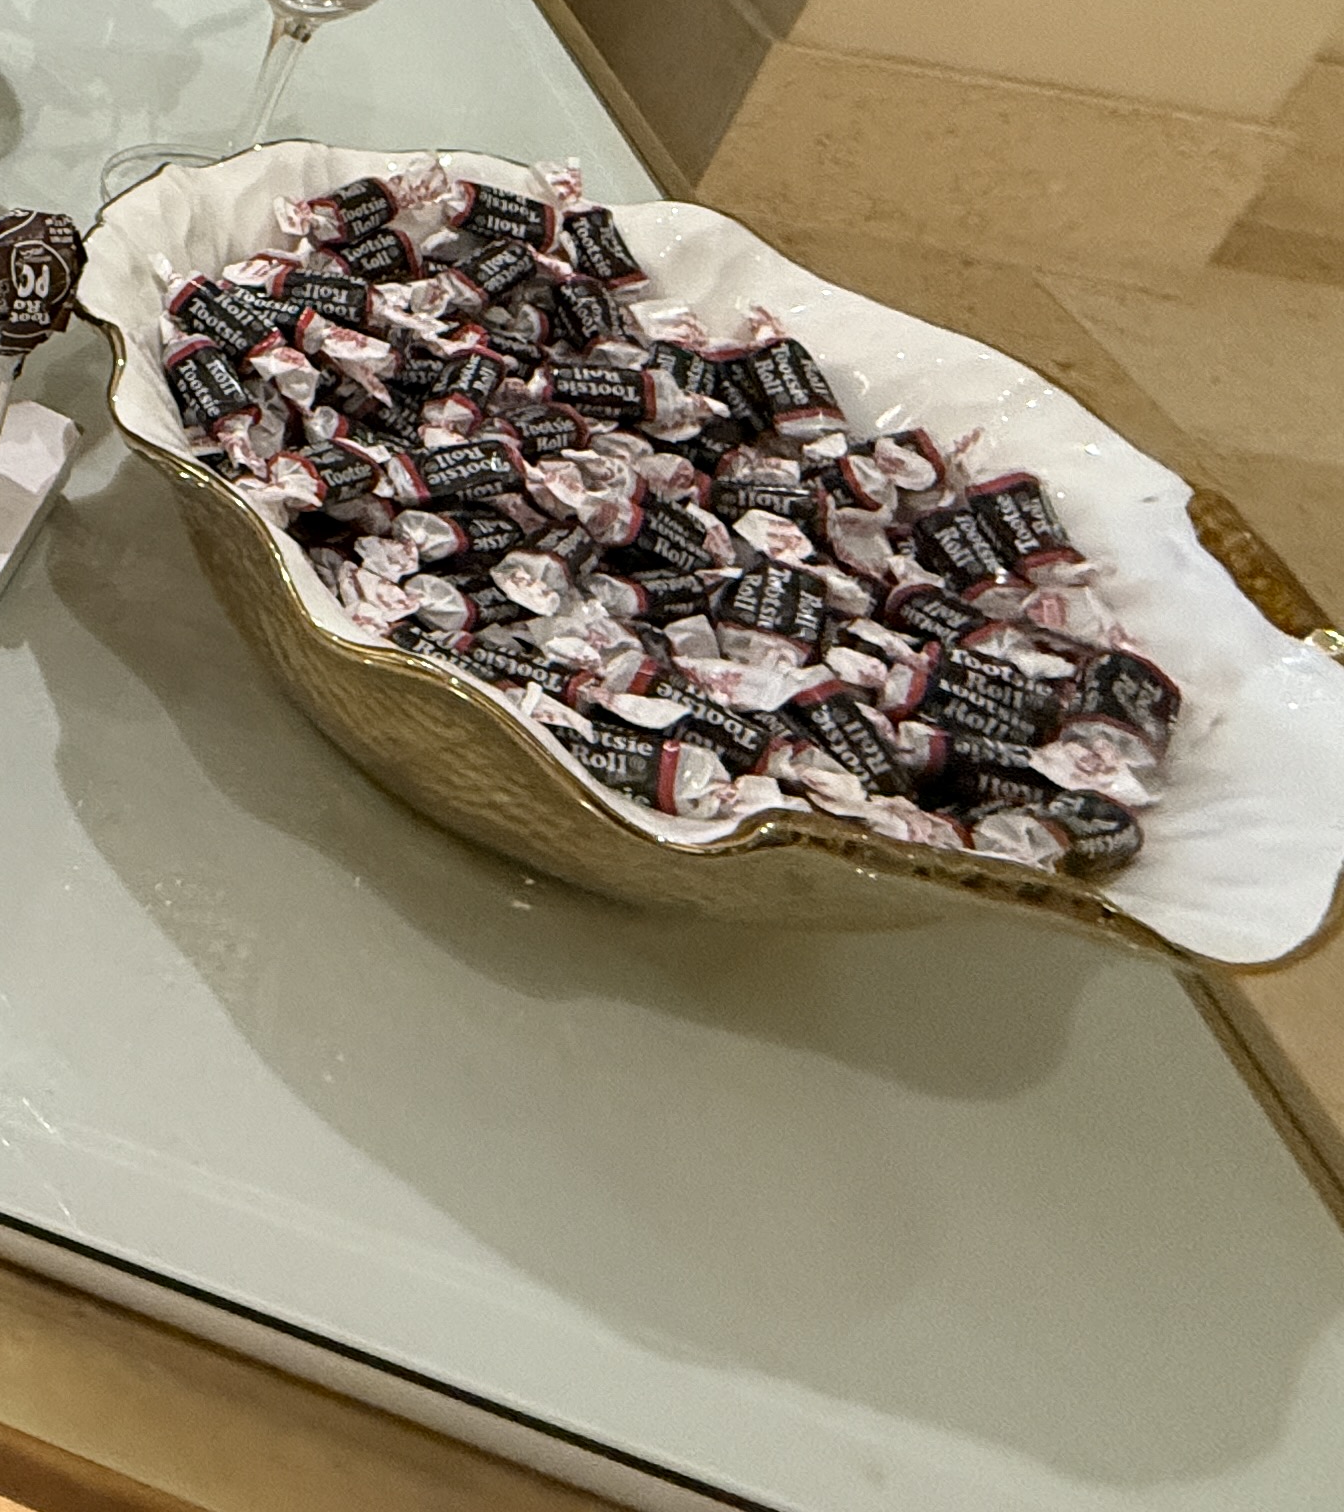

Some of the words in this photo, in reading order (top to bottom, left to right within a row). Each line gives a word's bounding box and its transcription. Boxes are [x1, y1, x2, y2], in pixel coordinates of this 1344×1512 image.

[340, 195, 388, 224] Tootsie
[486, 214, 528, 239] Roll
[341, 233, 397, 262] Tootsie
[572, 216, 613, 278] Tootsie
[10, 311, 52, 326] Toot
[12, 298, 43, 314] Ro
[213, 292, 256, 332] Roll
[189, 296, 249, 351] Tootsie
[178, 358, 221, 418] Tootsie
[754, 358, 786, 398] Roll
[769, 342, 811, 406] Tootsie
[557, 378, 643, 404] Tootsie
[319, 462, 374, 488] Tootsie
[426, 453, 512, 486] Tootsie
[435, 446, 486, 472] Roll
[472, 646, 565, 693] Tootsie
[570, 743, 628, 776] Roll
[843, 718, 893, 775] Roll
